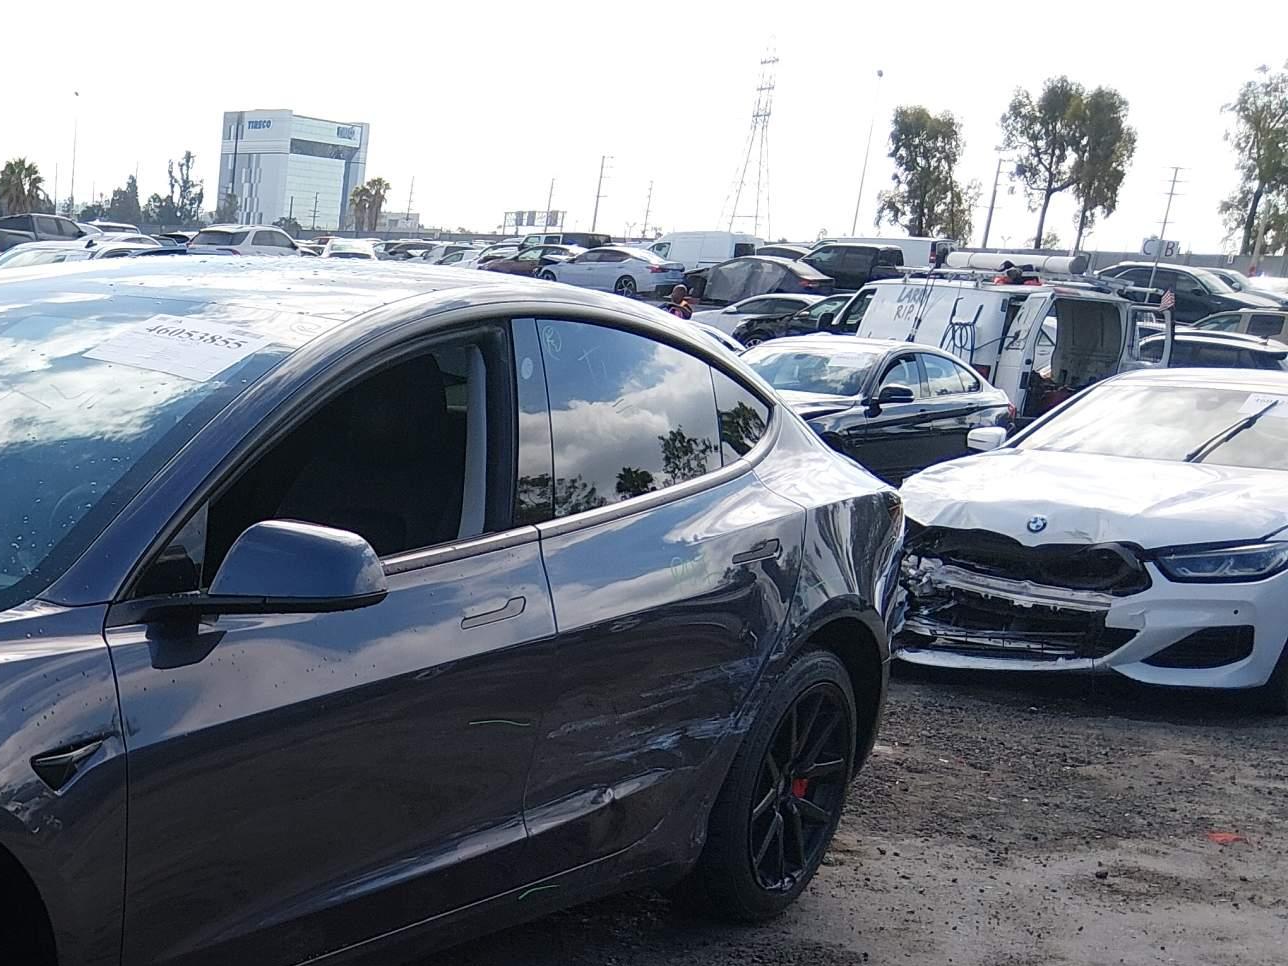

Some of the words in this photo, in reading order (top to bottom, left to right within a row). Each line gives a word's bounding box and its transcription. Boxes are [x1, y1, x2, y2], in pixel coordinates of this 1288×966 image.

[1143, 239, 1156, 255] C
[1164, 241, 1176, 257] B
[145, 324, 249, 350] 46053855
